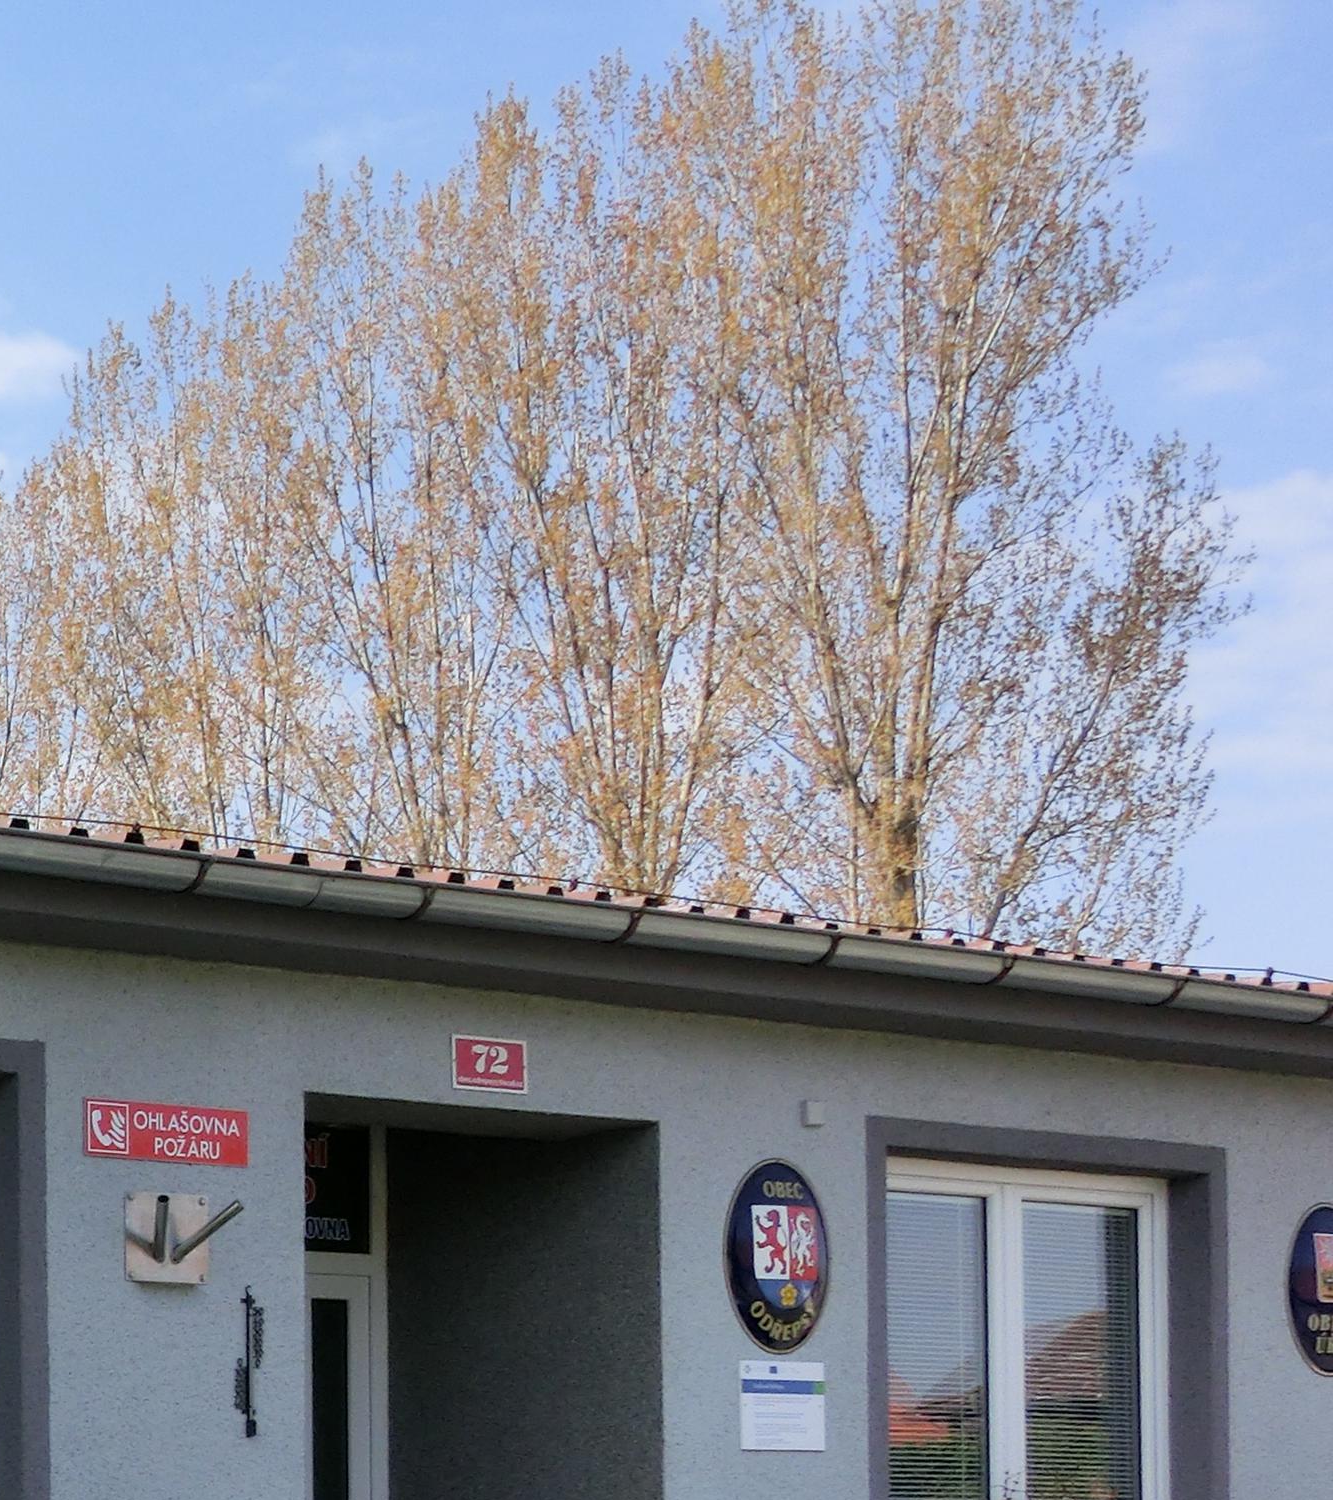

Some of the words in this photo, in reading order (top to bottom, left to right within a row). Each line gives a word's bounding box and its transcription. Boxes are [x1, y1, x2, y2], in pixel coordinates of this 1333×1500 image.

[471, 1044, 509, 1075] 72
[133, 1111, 240, 1137] OHLAŠOVNA
[154, 1135, 221, 1160] POŽÁRU
[763, 1180, 804, 1199] OBEC
[1307, 1313, 1333, 1332] OB
